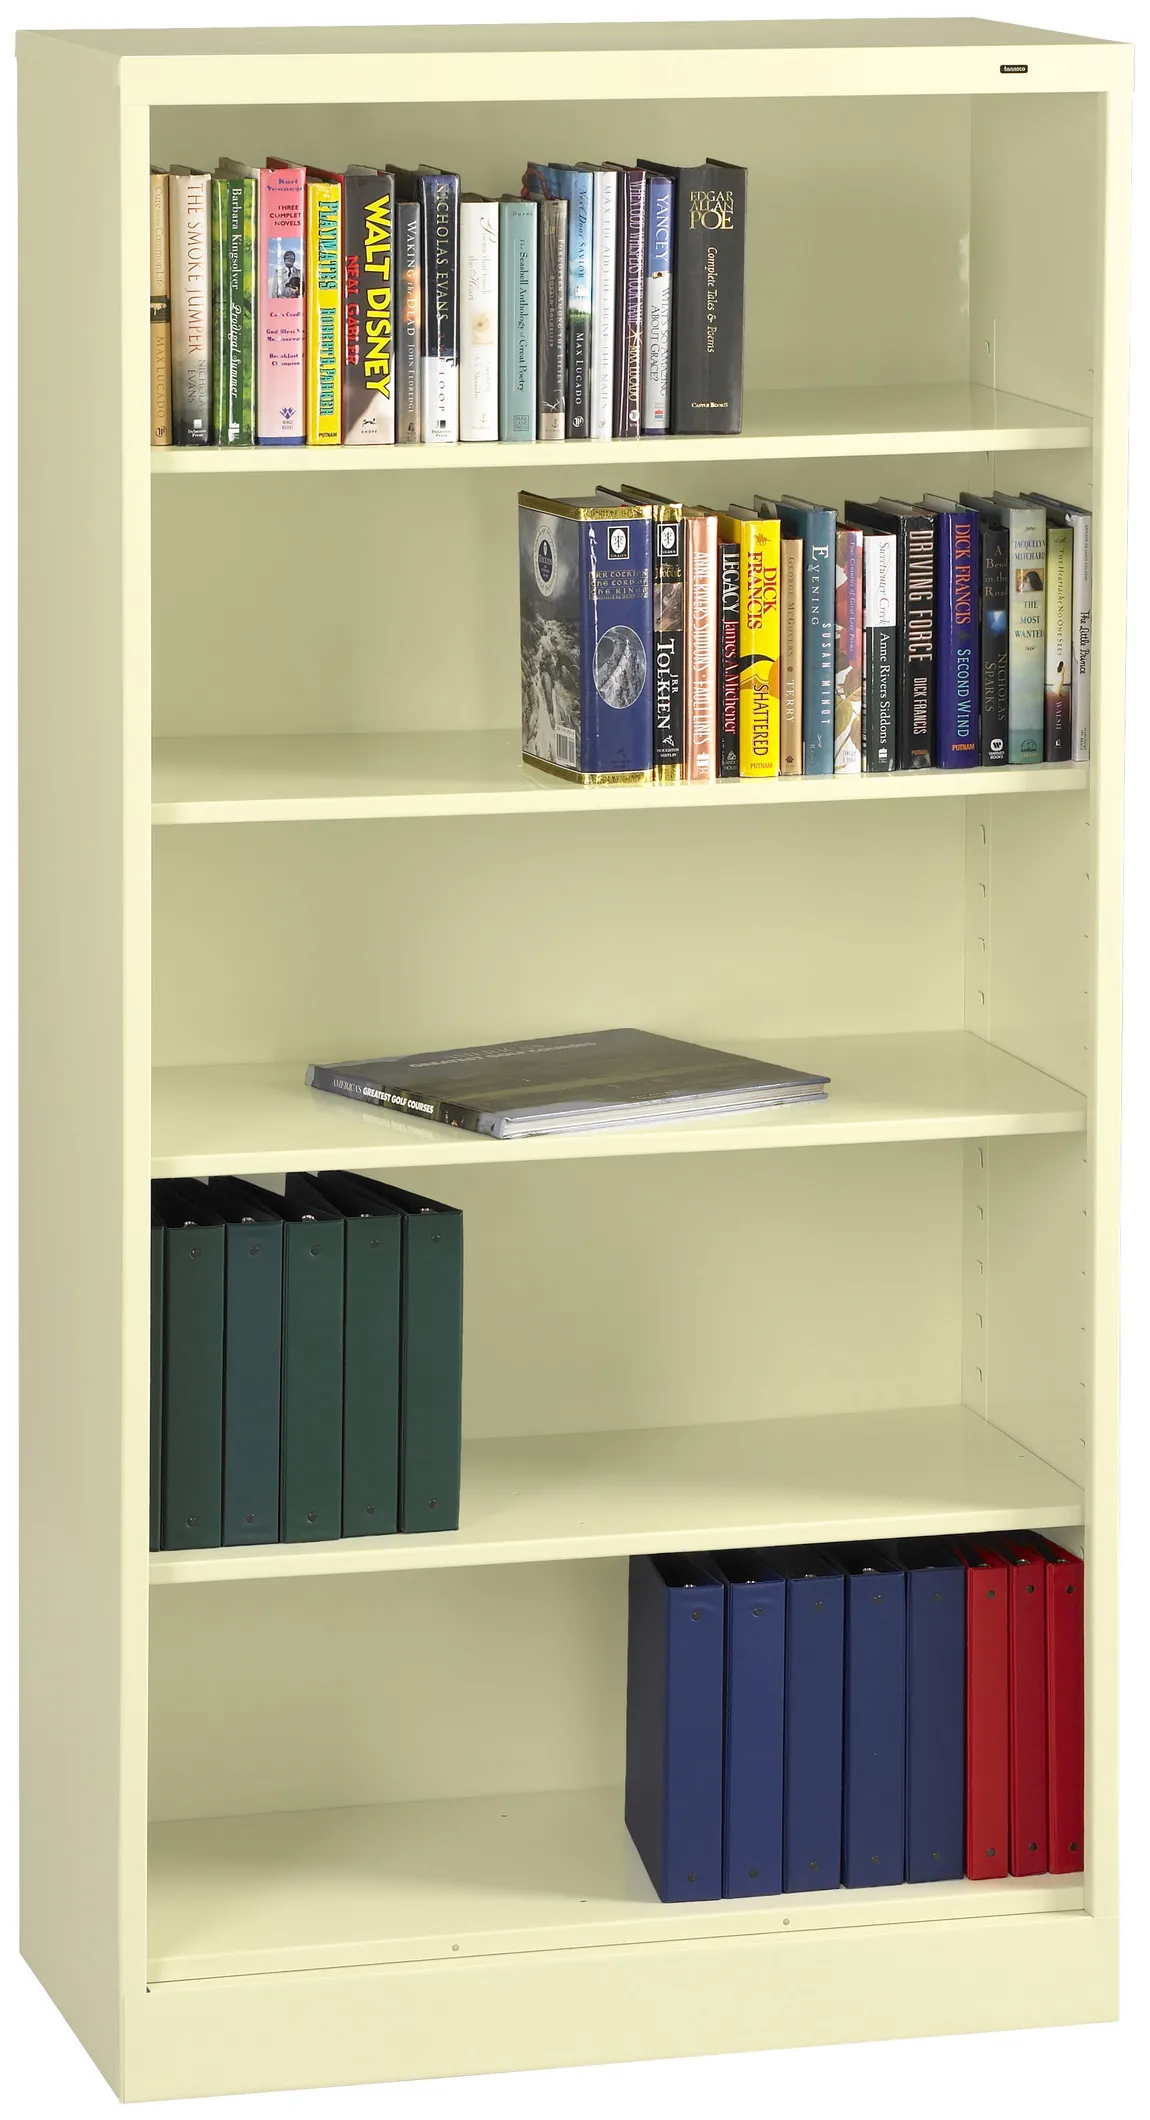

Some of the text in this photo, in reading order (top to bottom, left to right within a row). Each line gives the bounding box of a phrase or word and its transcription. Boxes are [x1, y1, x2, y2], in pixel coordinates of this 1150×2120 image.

[689, 211, 733, 230] POE
[690, 191, 733, 201] EDGAR
[690, 201, 734, 214] ALLAN
[229, 188, 242, 290] Barbara Kingsolver
[318, 200, 339, 290] PLAYMATES
[406, 220, 416, 278] WAKING
[436, 182, 449, 320] NICHOLAS EVANS
[628, 180, 644, 326] WHEN GOD WHISPERS YOUR NAME
[656, 194, 670, 262] YANCEY
[185, 184, 204, 354] THE SMOKE JUMPER
[520, 252, 528, 285] Seashell
[578, 242, 586, 278] SAVIOR
[345, 256, 360, 365] NEAL GABLER
[364, 194, 392, 400] WALT DISNEY
[407, 300, 416, 336] DEAD
[518, 288, 528, 330] Anthology
[704, 247, 718, 353] Complete Tales & Poems
[228, 302, 242, 398] Prodigal Summer
[320, 308, 336, 416] ROBERT PARKER
[408, 344, 416, 366] JOHN
[518, 339, 528, 366] Great
[650, 305, 660, 382] ABOUT GRACE?
[660, 330, 668, 344] SO
[156, 336, 166, 418] MAX LUCADO
[188, 369, 196, 404] EVANS
[198, 360, 206, 412] NICHOLAS
[516, 367, 528, 392] Poetry
[575, 332, 584, 405] MAX LUCADO
[629, 345, 638, 402] MAX LUCADO
[660, 346, 668, 396] AMAZING
[955, 524, 971, 624] DICK FRANCIS
[994, 546, 1002, 555] A
[694, 552, 710, 671] ANNE RIVERS SIDDONS
[722, 553, 740, 613] LEGACY
[747, 552, 762, 630] FRANCIS
[763, 567, 777, 614] DICK
[812, 545, 829, 625] EVENING
[880, 542, 890, 626] Sweetwater Creek
[909, 530, 933, 662] DRIVING FORCE
[1024, 600, 1038, 608] THE
[722, 619, 738, 658] James
[1020, 616, 1040, 624] MOST
[1079, 610, 1090, 675] The Little Prince
[657, 638, 674, 730] TOLKIEN
[670, 673, 678, 693] JRR
[693, 681, 710, 710] FAULT
[786, 680, 794, 722] TERRY
[821, 623, 831, 724] SUSAN MINOT
[880, 632, 891, 744] Anne Rivers Siddons
[957, 649, 971, 737] SECOND WIND
[985, 662, 996, 712] SPARKS
[998, 654, 1008, 721] NICHOLAS
[693, 715, 710, 745] LINES
[724, 675, 739, 734] Michener
[754, 684, 769, 756] SHATTERED
[913, 678, 927, 735] DICK FRANCIS
[952, 743, 975, 751] PUTNAM
[332, 1078, 434, 1114] AMERICA'S GREATEST GOLF COURSES
